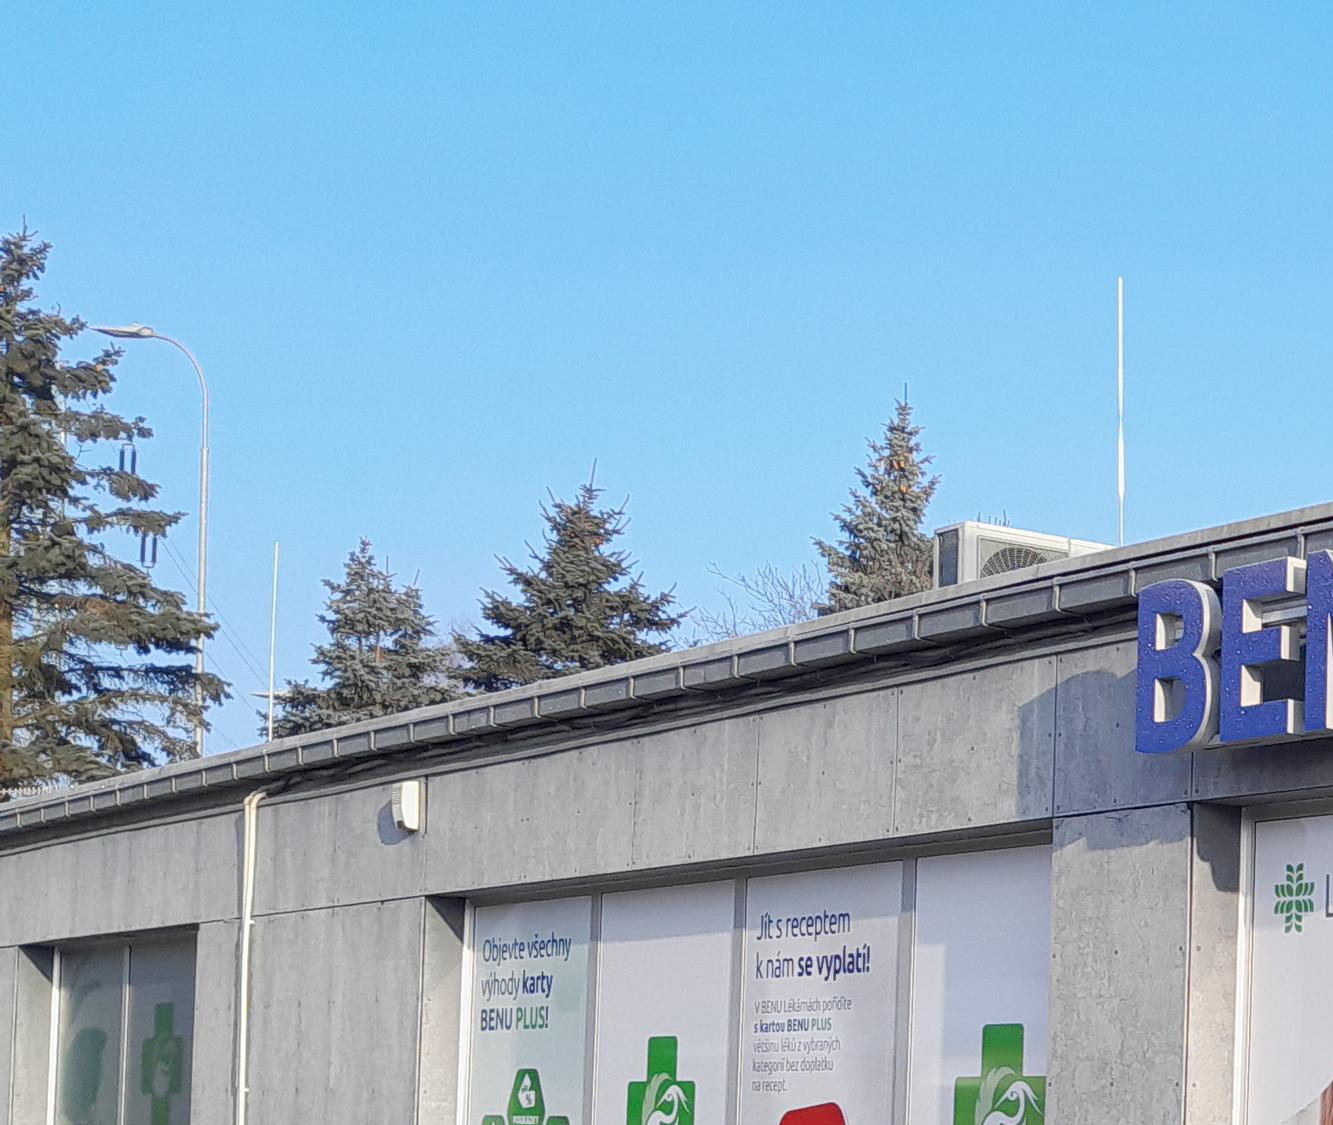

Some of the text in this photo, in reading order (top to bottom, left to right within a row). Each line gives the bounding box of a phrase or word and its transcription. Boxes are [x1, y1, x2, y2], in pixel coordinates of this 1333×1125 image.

[756, 909, 850, 941] Jít s receptem
[482, 931, 571, 966] Objevte všechny
[756, 943, 870, 981] k nám se vyplatí!
[481, 968, 553, 1002] výhody karty
[480, 1005, 548, 1031] BENU PLUS!
[761, 1000, 782, 1014] BENU
[754, 1017, 832, 1033] s kartou BENU PLUS
[786, 1058, 799, 1071] bez
[752, 1081, 760, 1091] na
